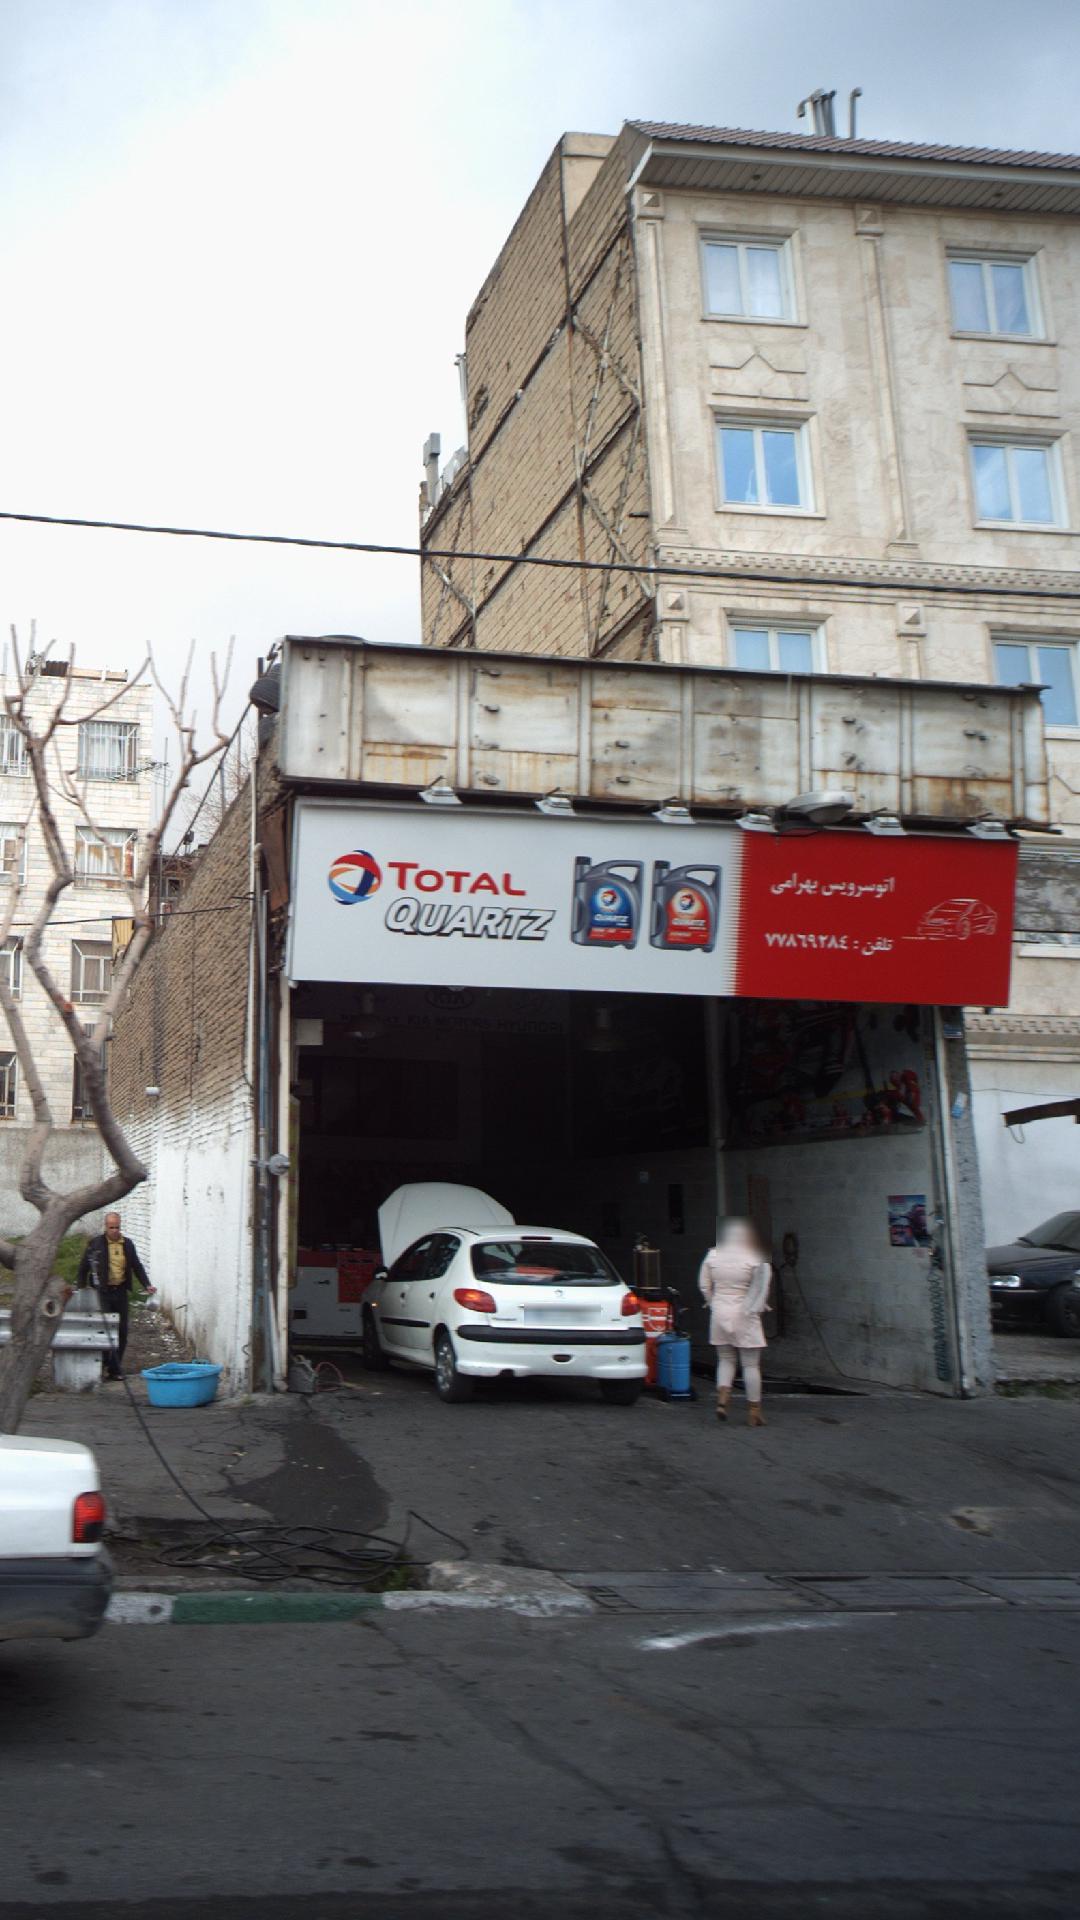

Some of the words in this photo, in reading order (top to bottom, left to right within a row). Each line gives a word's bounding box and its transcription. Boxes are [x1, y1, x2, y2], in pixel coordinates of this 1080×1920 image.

[388, 862, 526, 897] TOTAL
[822, 876, 895, 898] اتوسرویس
[385, 896, 556, 942] QUARTZ
